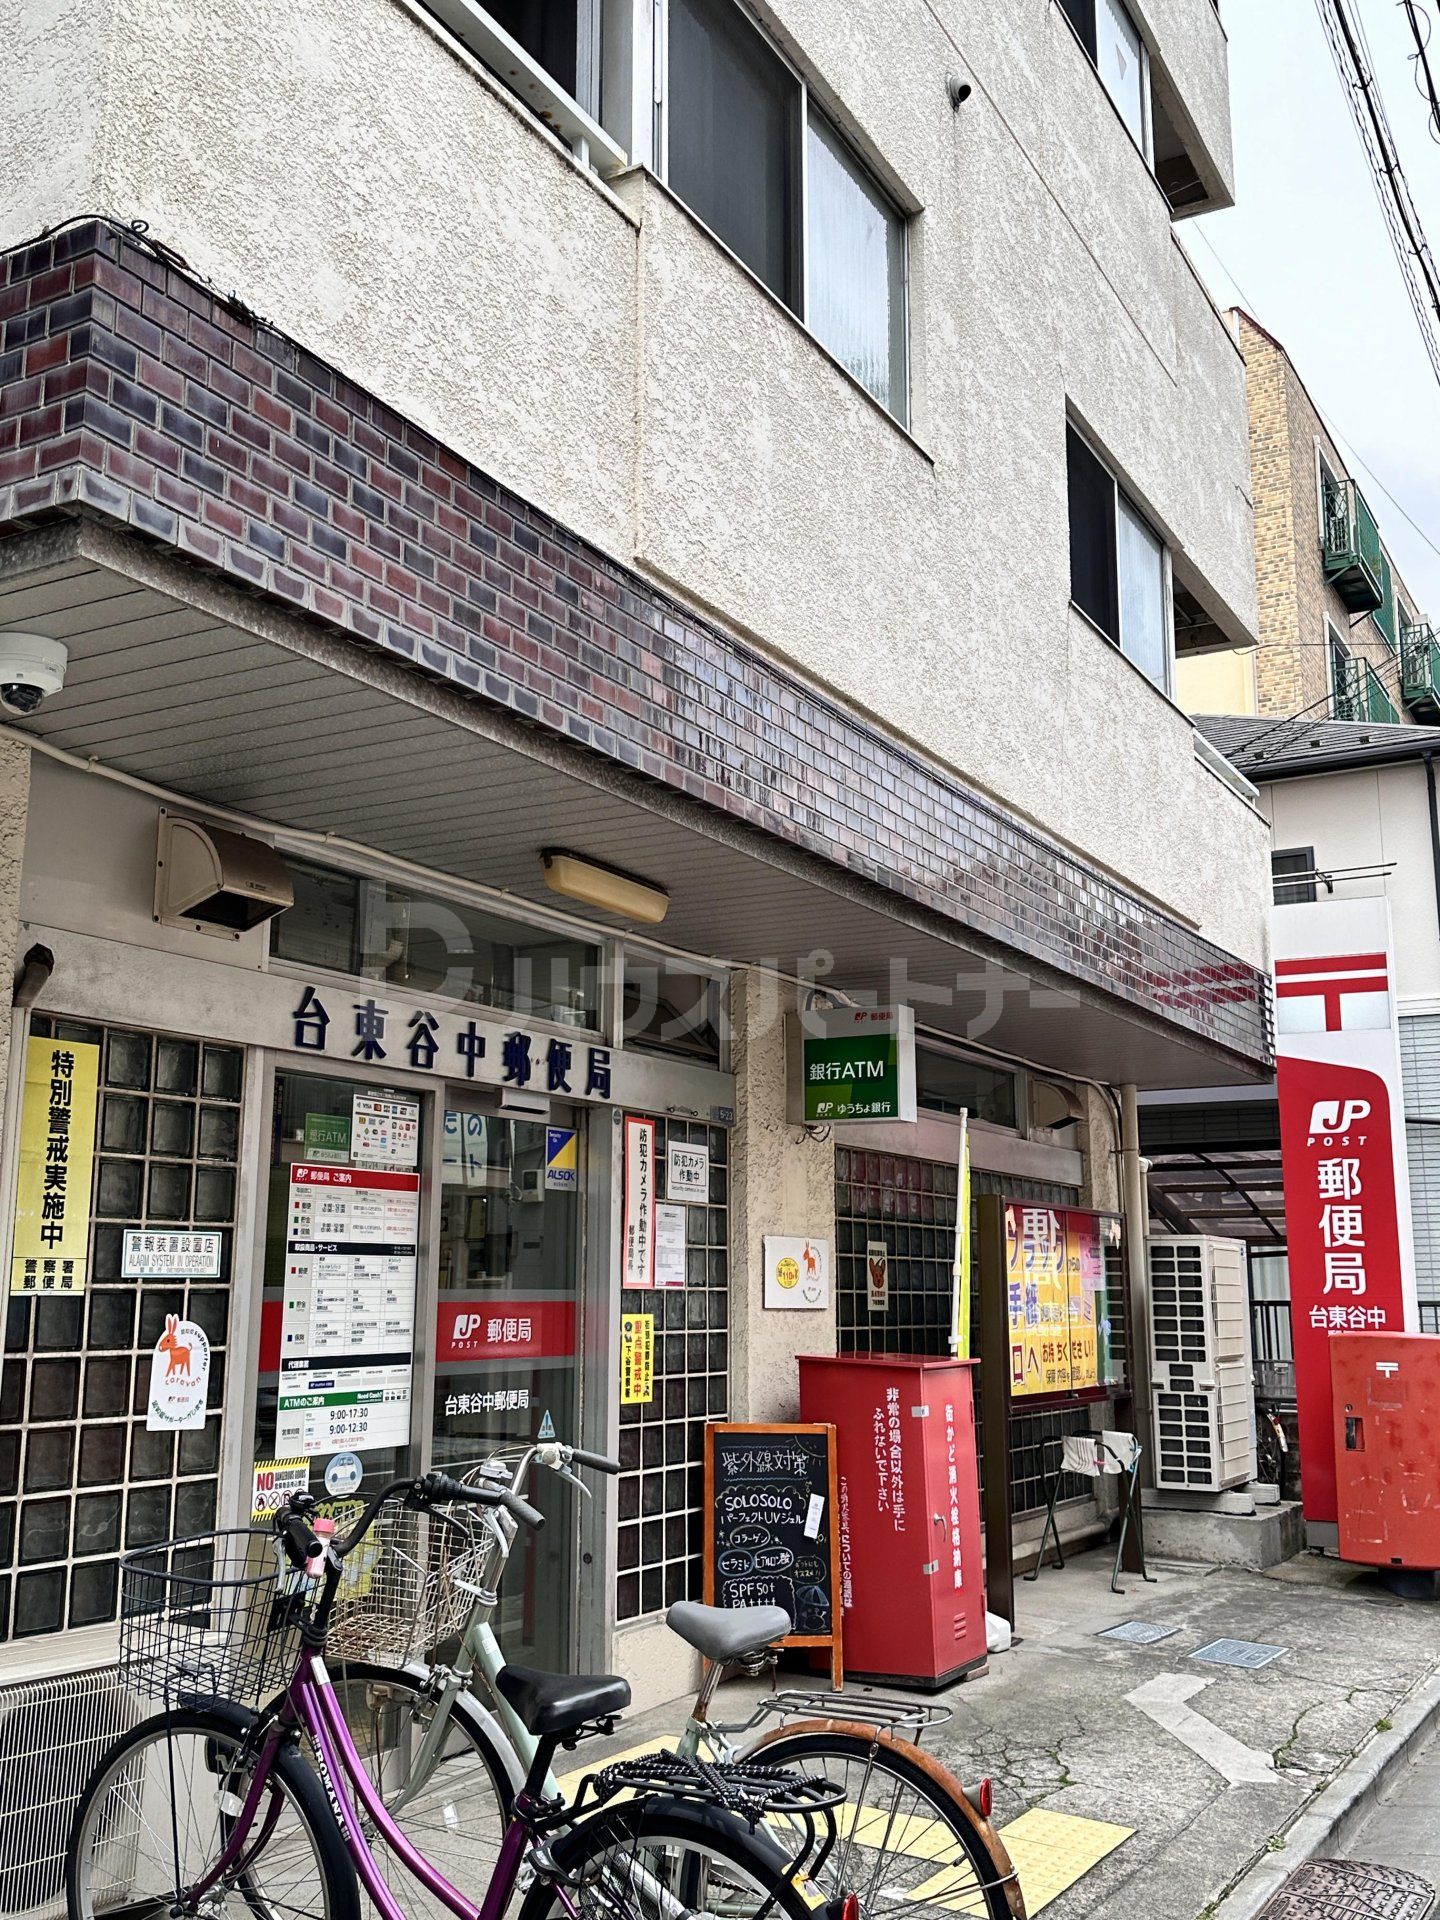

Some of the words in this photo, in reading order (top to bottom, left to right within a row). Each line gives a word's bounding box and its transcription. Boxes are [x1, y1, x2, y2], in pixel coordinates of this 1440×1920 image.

[293, 985, 612, 1100] 台東谷中郵便局
[809, 1060, 884, 1080] 銀行ATM
[837, 1101, 891, 1114] ゆうちょ銀行
[1307, 1136, 1367, 1147] POST
[40, 1050, 75, 1250] 特別警戒実施中
[674, 1153, 704, 1169] 防犯カメラ
[333, 1173, 352, 1183] ご案内
[547, 1169, 575, 1181] ALSOK
[679, 1169, 700, 1183] 作動中
[637, 1128, 648, 1279] 防犯カメラ作動中です
[1317, 1158, 1367, 1296] 郵便局
[131, 1235, 214, 1253] 警報装置設置店
[24, 1259, 75, 1276] 警察署
[129, 1254, 150, 1266] ALARM
[151, 1255, 175, 1267] SYSTEM
[185, 1256, 214, 1268] OPERATION
[23, 1275, 73, 1290] 郵便局
[1309, 1304, 1386, 1330] 台東谷中
[487, 1318, 531, 1343] 郵便局
[165, 1376, 202, 1387] caravan
[284, 1396, 325, 1408] ATMのご案内
[445, 1389, 529, 1416] 台東谷中郵便局
[330, 1408, 368, 1420] 9:00-17:30
[330, 1422, 368, 1434] 9:00-12:30
[722, 1450, 809, 1475] 紫外線対策
[873, 1407, 889, 1512] ふれないで下さい
[886, 1387, 906, 1532] 非常の場合以外は手に
[257, 1472, 274, 1491] NO
[725, 1494, 792, 1511] SOLOSOLO
[945, 1404, 963, 1589] 街かど消火栓格納庫
[721, 1512, 804, 1524] パーフェクトUVジェル
[734, 1534, 767, 1543] コラーゲン
[721, 1559, 750, 1569] セラミド
[755, 1552, 791, 1568] ヒアルロン酸
[730, 1583, 753, 1598] SPF
[315, 1746, 344, 1828] ROMANA
